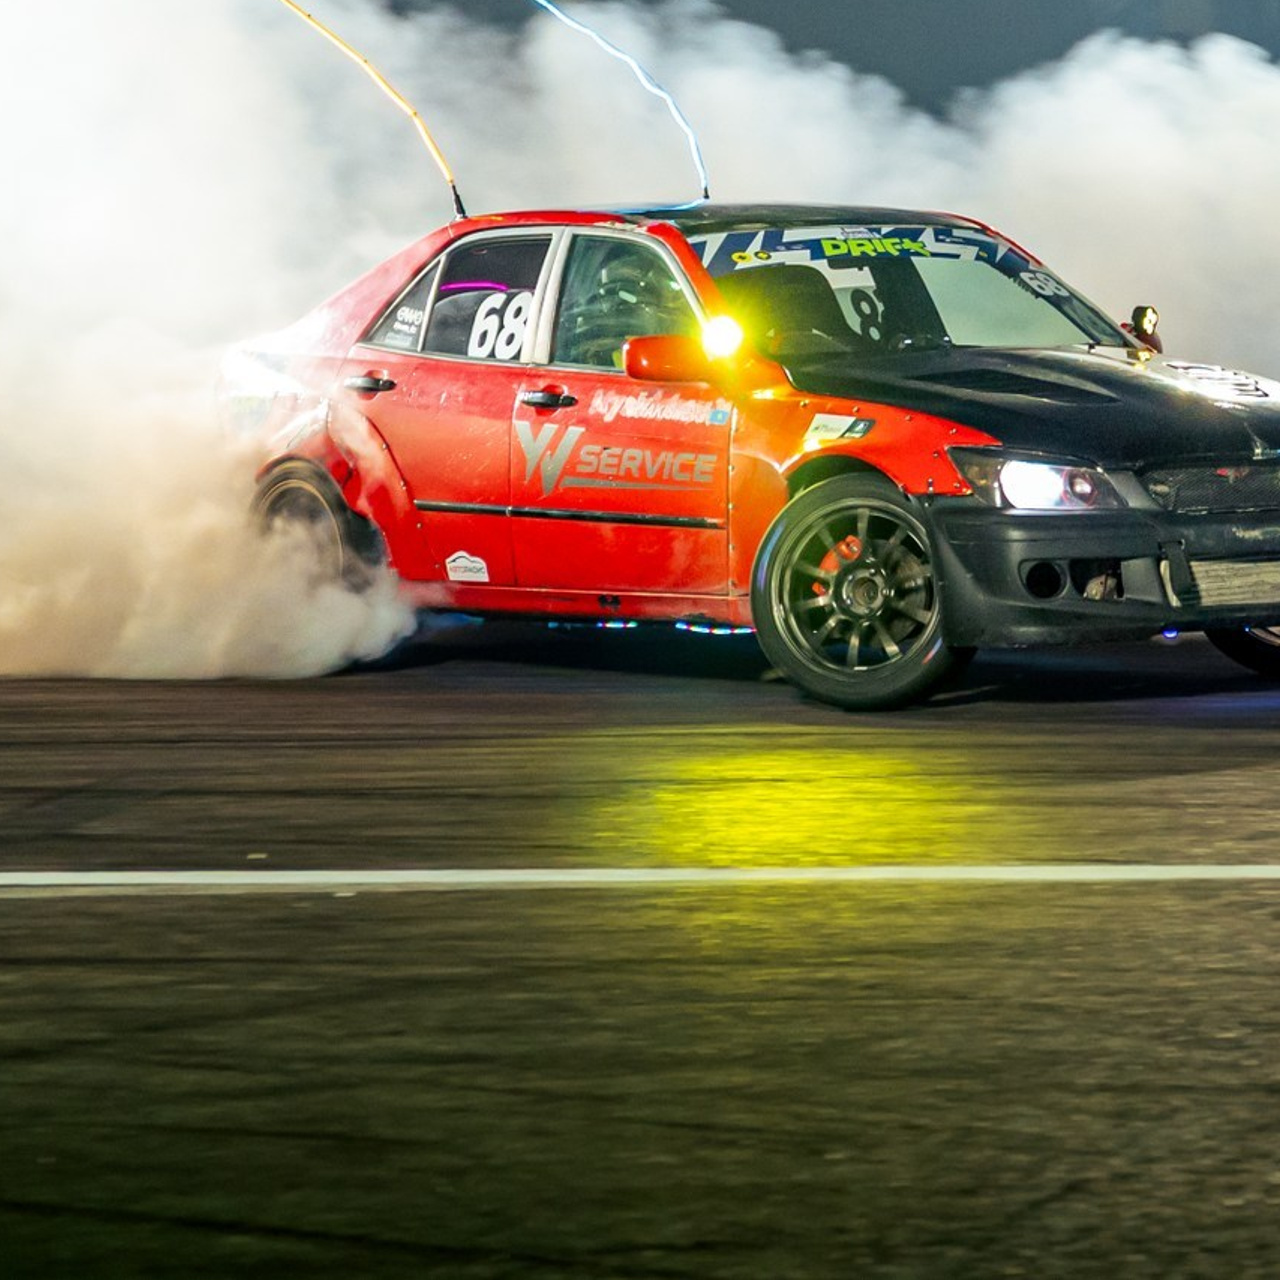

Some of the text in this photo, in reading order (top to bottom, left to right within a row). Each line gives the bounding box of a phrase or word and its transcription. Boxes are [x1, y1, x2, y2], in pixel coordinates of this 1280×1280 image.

[1019, 272, 1071, 296] 68
[467, 292, 534, 360] 68
[576, 444, 718, 482] SERVICE
